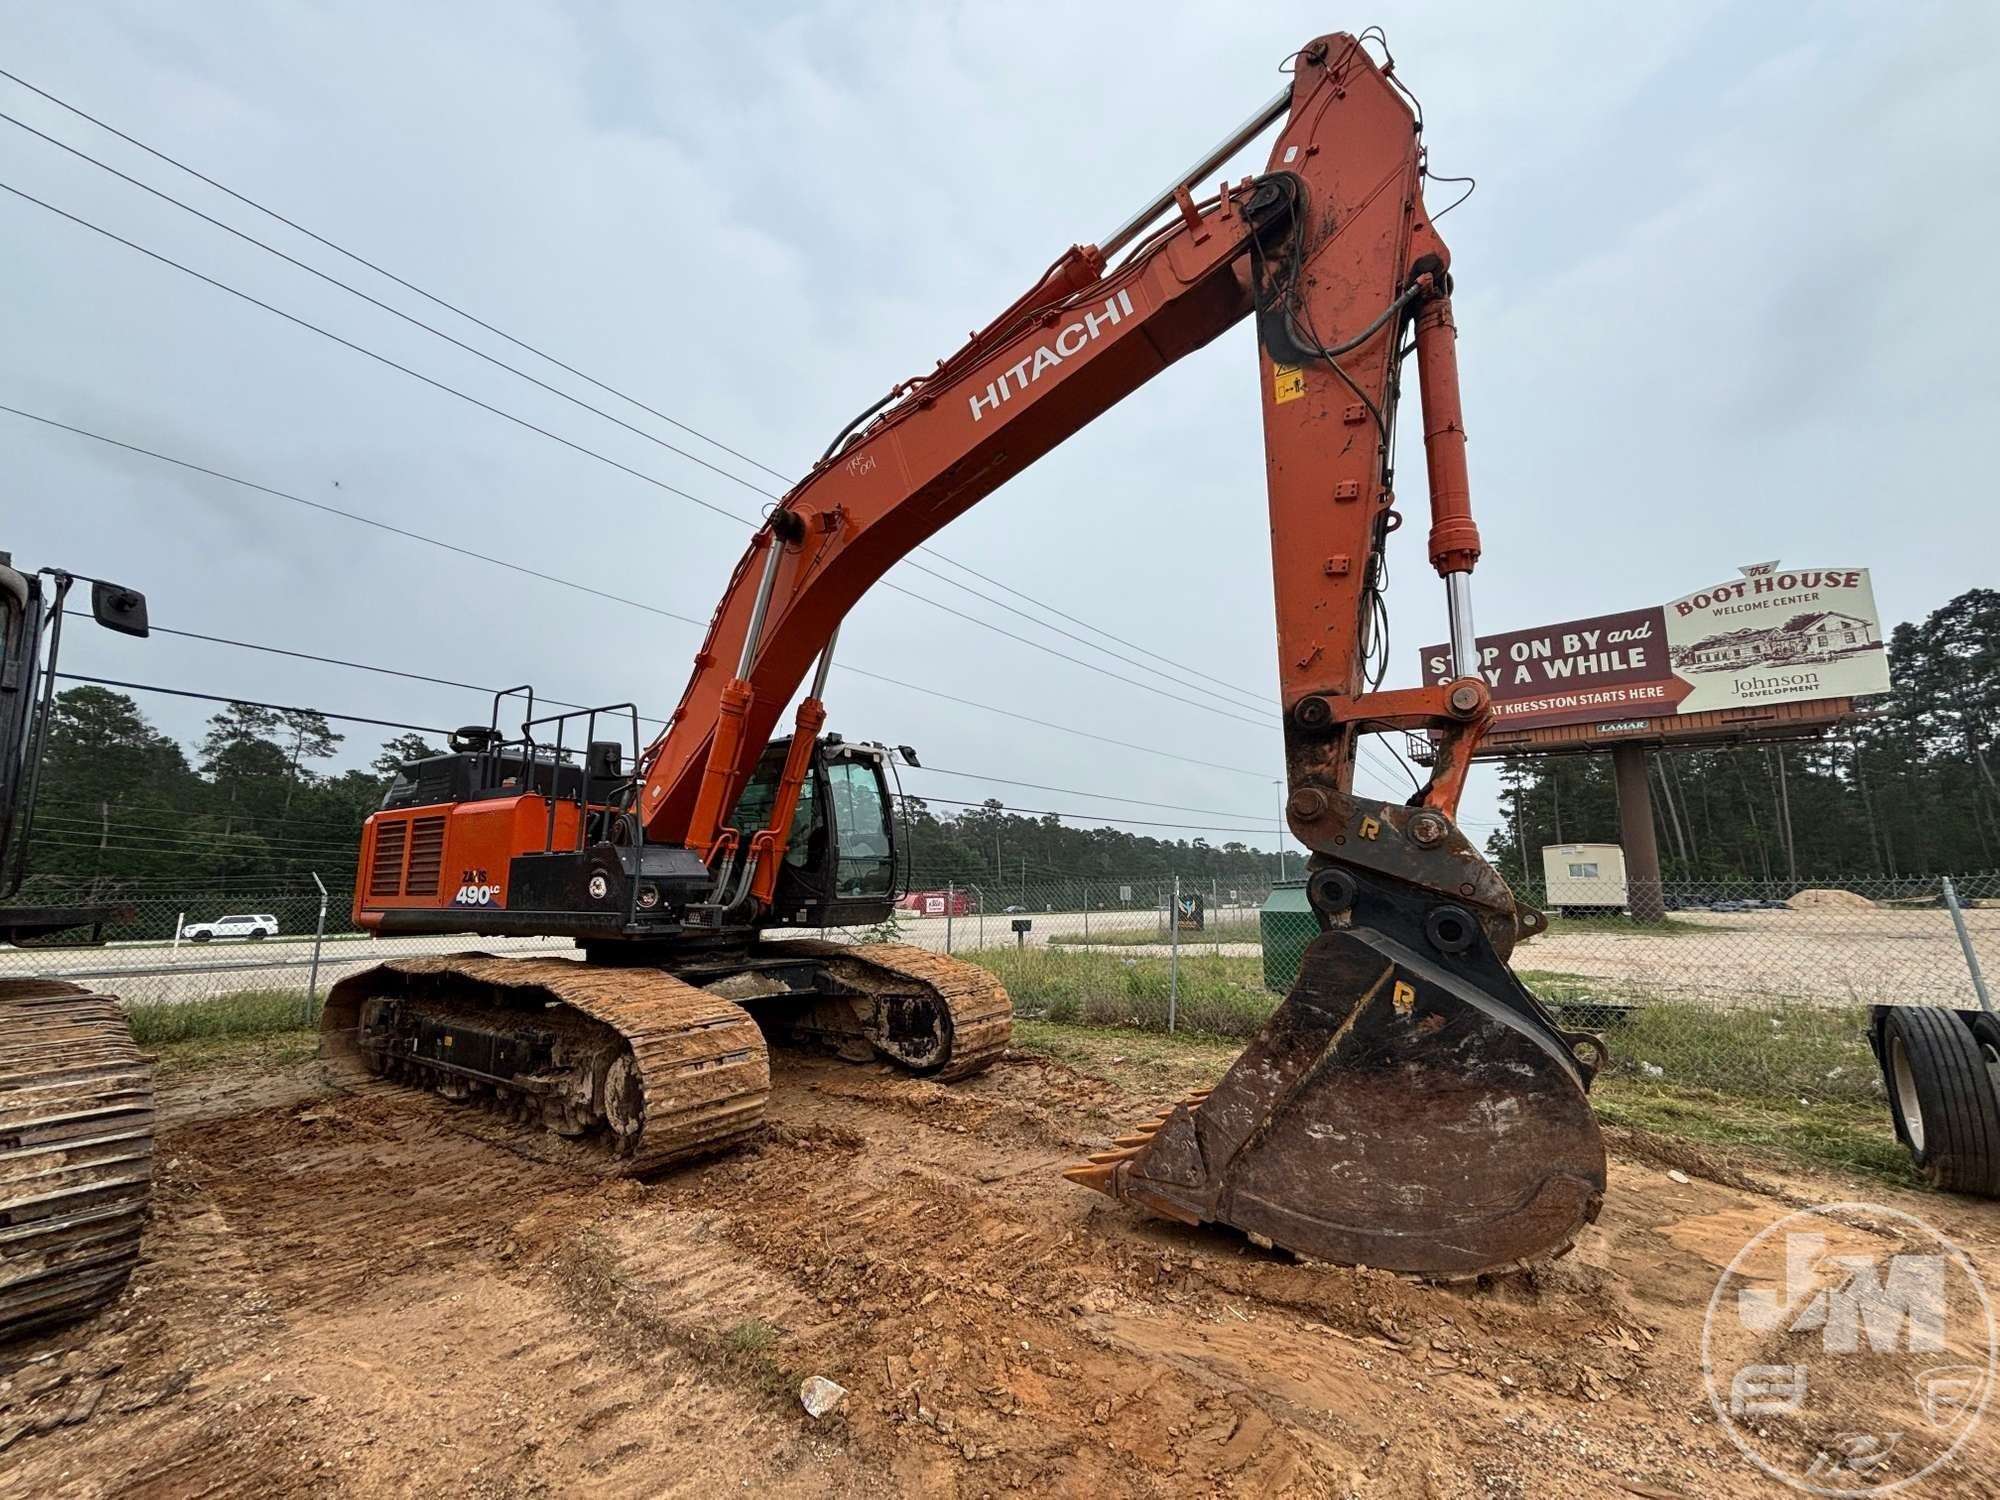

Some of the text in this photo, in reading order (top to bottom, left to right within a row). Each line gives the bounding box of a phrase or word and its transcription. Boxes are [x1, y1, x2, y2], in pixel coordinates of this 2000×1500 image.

[968, 288, 1135, 422] HITACHI
[1748, 565, 1771, 577] the
[1674, 572, 1861, 617] BOOT HOUSE
[1712, 592, 1820, 617] WELCOME CENTER
[1430, 620, 1653, 674] SP ON BY and
[1514, 664, 1533, 685] A
[1541, 647, 1647, 680] WHILE
[1731, 672, 1818, 694] Johnson
[1741, 684, 1820, 699] DEVELOPMENT
[1505, 696, 1577, 715] KRESSTON
[1579, 690, 1626, 706] STARTS
[1629, 686, 1665, 700] HERE
[1601, 721, 1646, 732] LAMAR
